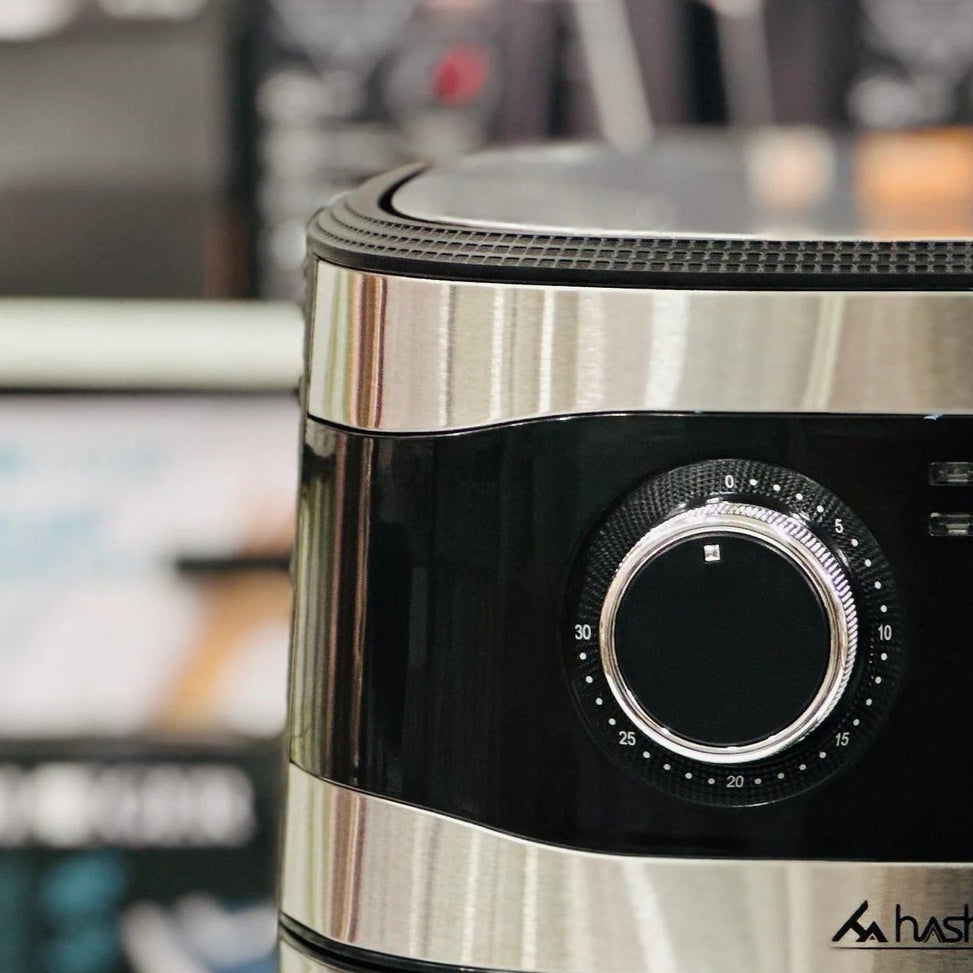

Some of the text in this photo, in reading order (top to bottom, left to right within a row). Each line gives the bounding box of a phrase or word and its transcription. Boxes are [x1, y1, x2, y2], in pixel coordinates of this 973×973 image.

[724, 475, 735, 488] 0
[835, 519, 844, 533] 5
[574, 624, 591, 640] 30
[878, 625, 892, 640] 10
[618, 731, 637, 746] 25
[835, 732, 850, 747] 15
[726, 775, 745, 788] 20
